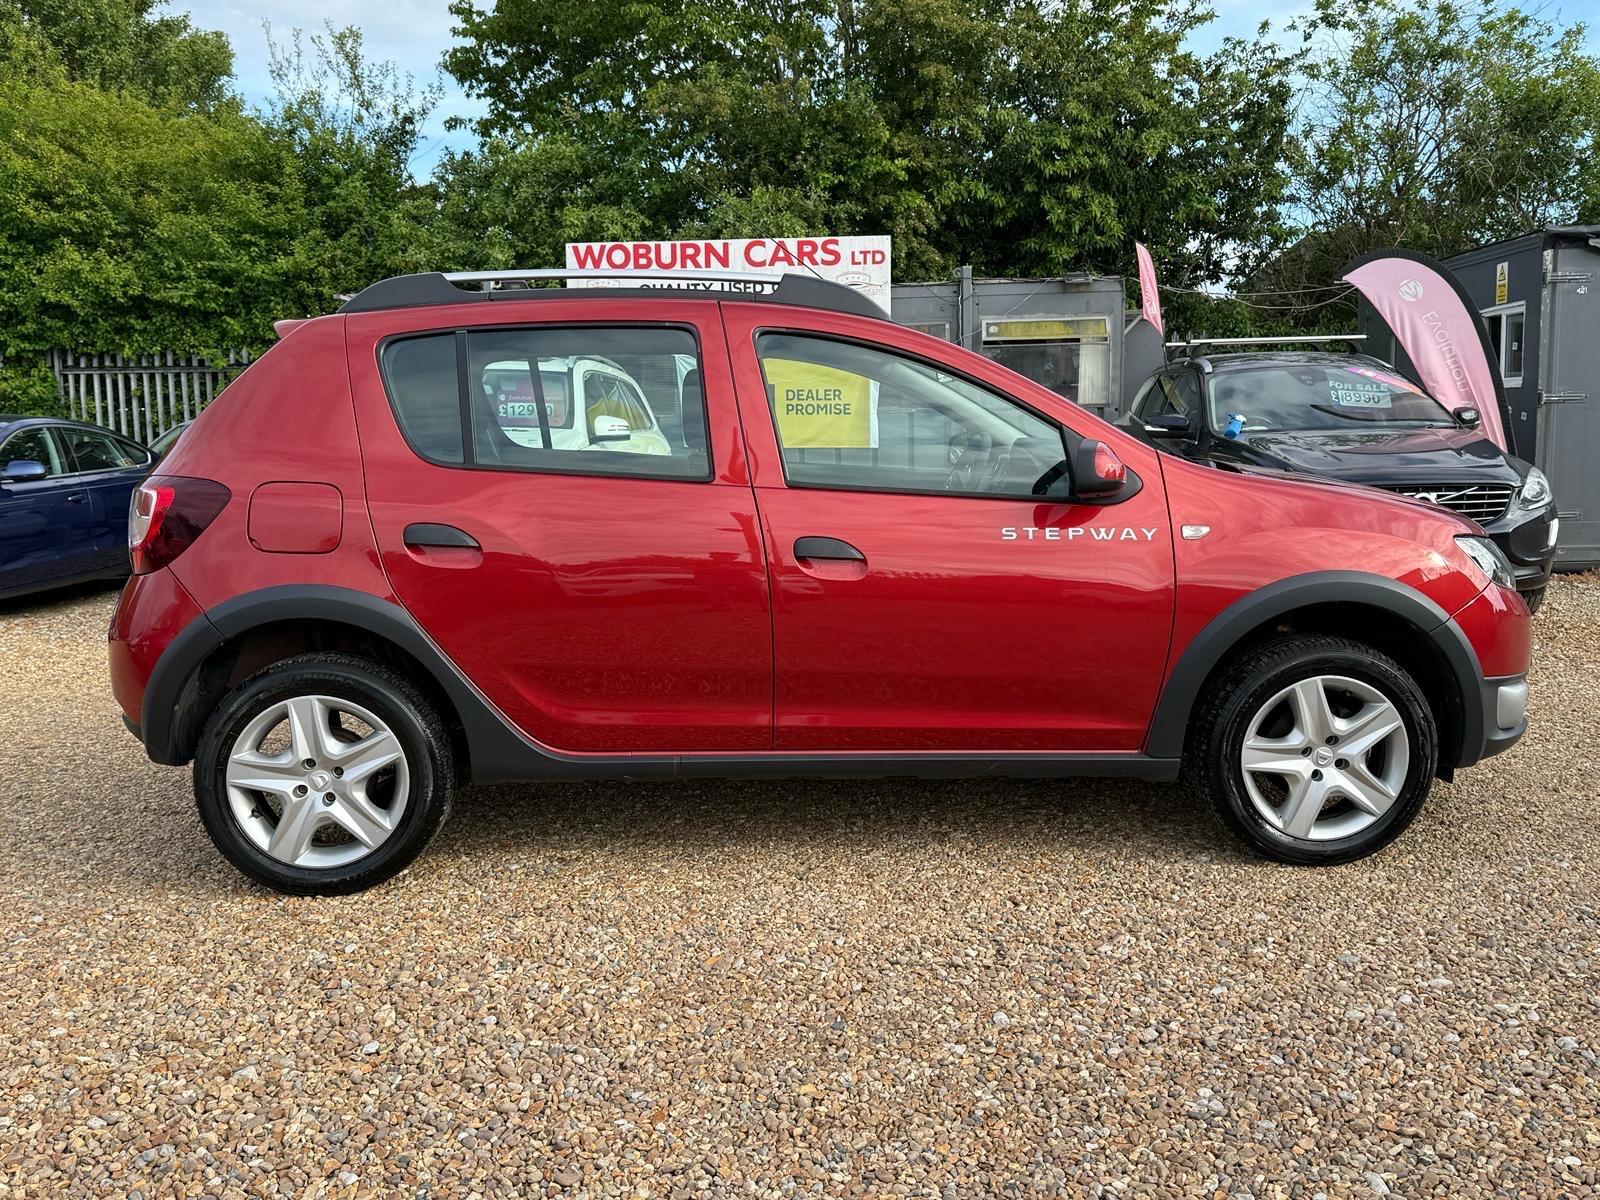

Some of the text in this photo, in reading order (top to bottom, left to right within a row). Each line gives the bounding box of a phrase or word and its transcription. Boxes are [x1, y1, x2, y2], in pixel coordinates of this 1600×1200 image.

[571, 239, 886, 270] WOBURN CARS LTD
[720, 283, 765, 293] USED
[1328, 380, 1389, 391] FOR SALE
[786, 389, 842, 401] DEALER
[498, 404, 553, 417] £1290
[786, 403, 851, 415] PROMISE
[1001, 527, 1158, 540] STEPWAY
